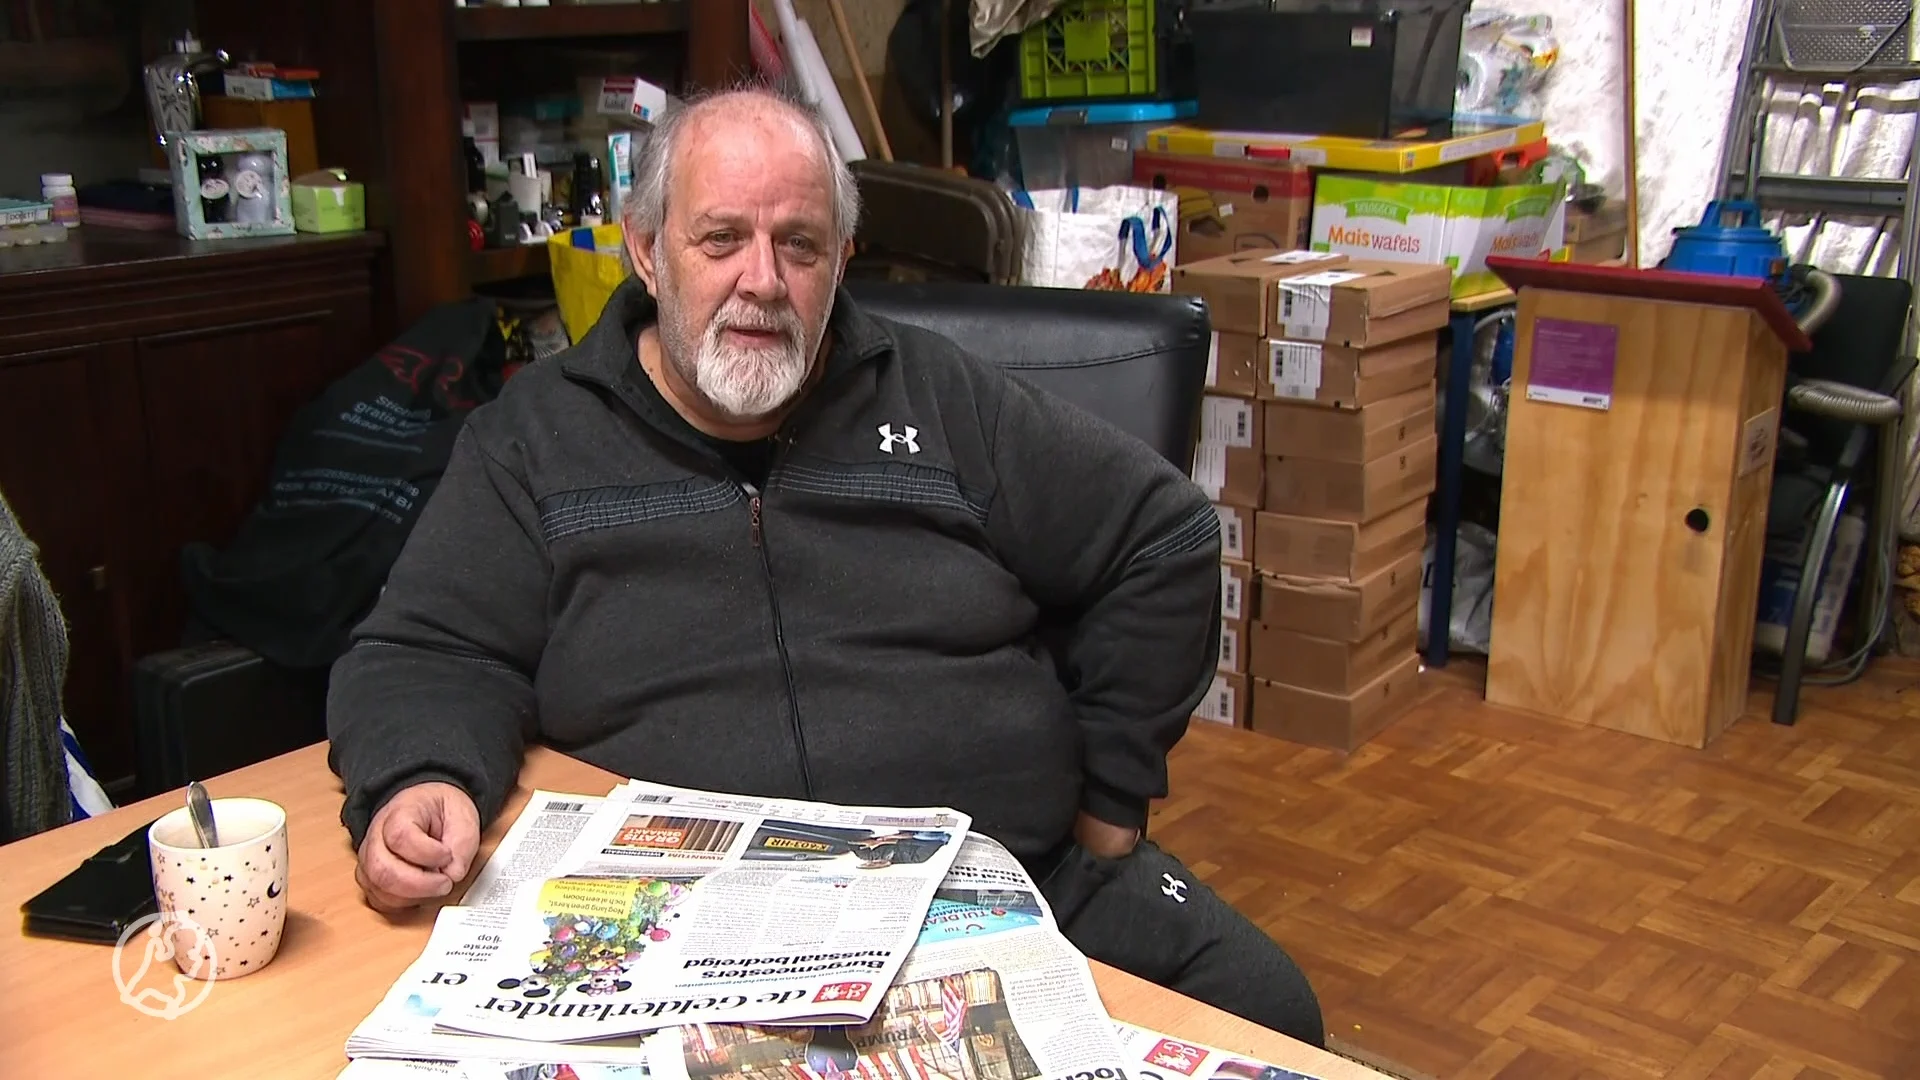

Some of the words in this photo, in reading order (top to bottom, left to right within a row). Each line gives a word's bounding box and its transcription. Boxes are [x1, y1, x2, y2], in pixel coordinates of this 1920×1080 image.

[623, 834, 679, 844] GRATIS
[563, 893, 586, 902] boom
[571, 902, 590, 911] geen
[591, 904, 607, 914] lang
[608, 907, 624, 915] Nog
[963, 911, 988, 920] TUI
[477, 934, 492, 942] op
[683, 956, 791, 969] bedreigd
[792, 950, 891, 965] massaal
[702, 960, 885, 979] Burgemeesters
[756, 989, 807, 1004] de
[475, 995, 748, 1021] Gelderlander
